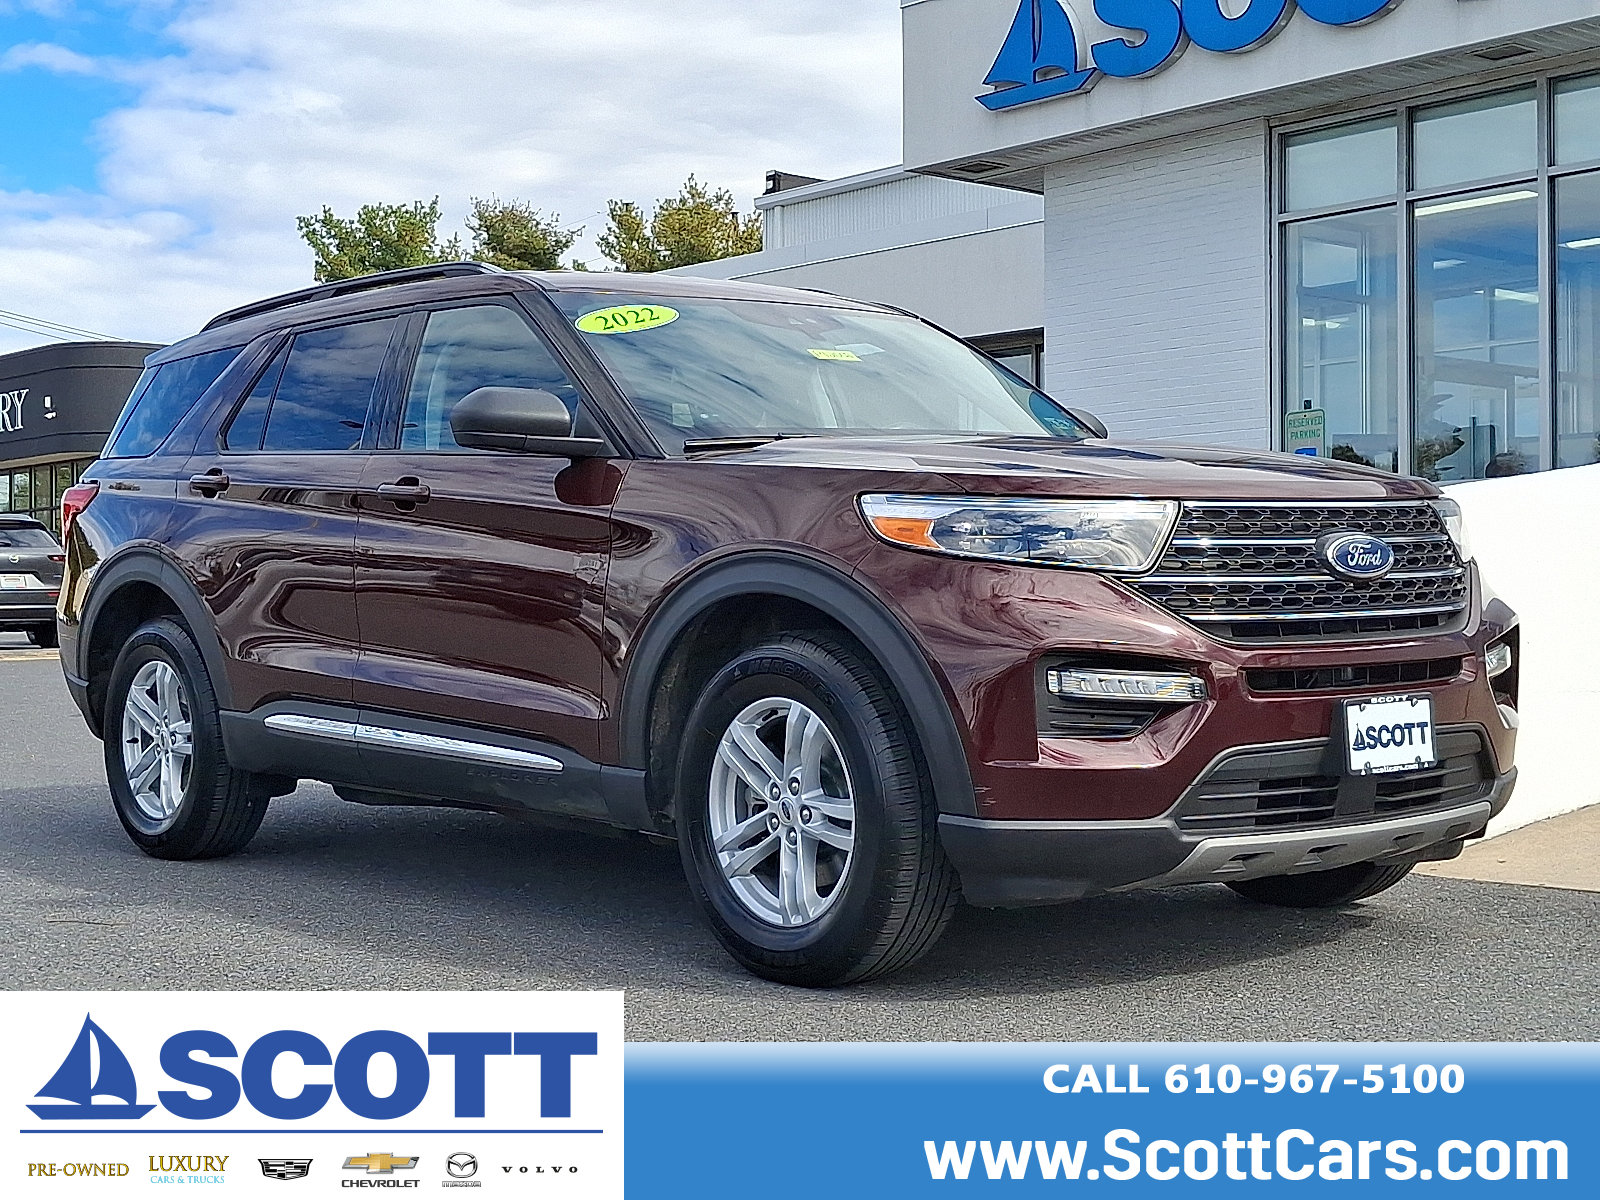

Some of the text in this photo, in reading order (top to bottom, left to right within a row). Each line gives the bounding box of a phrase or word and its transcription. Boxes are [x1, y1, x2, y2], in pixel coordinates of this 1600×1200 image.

[594, 307, 660, 330] 2022
[1288, 416, 1322, 428] RESERVED
[1290, 428, 1321, 440] PARKING
[1347, 543, 1382, 567] Ford
[1370, 694, 1409, 704] SCOTT
[1365, 721, 1428, 750] SCOTT
